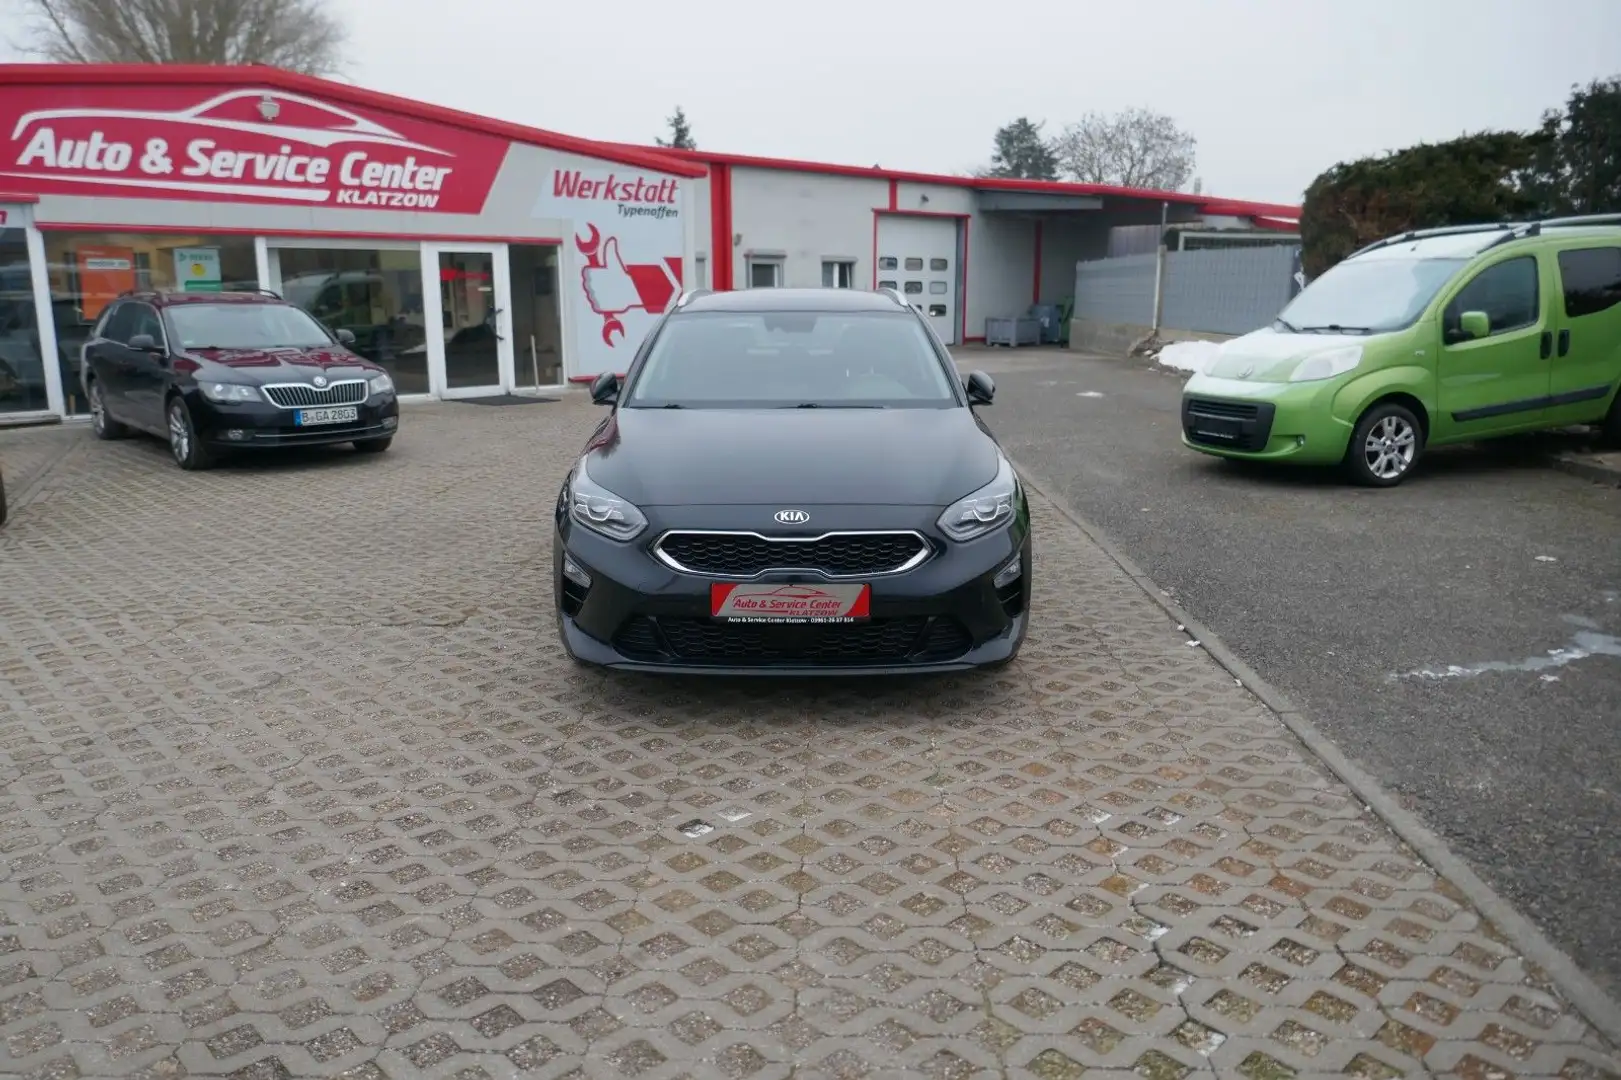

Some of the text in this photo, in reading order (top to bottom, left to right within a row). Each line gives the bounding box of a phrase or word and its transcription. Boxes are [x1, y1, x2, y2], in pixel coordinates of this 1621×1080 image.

[16, 127, 453, 191] Auto & Service Center
[553, 170, 679, 204] Werkstatt
[336, 189, 440, 208] KLATZOW
[617, 204, 679, 219] Typenoffen
[301, 412, 309, 423] B
[780, 511, 804, 521] KIA
[733, 599, 842, 609] Auto & Service Center
